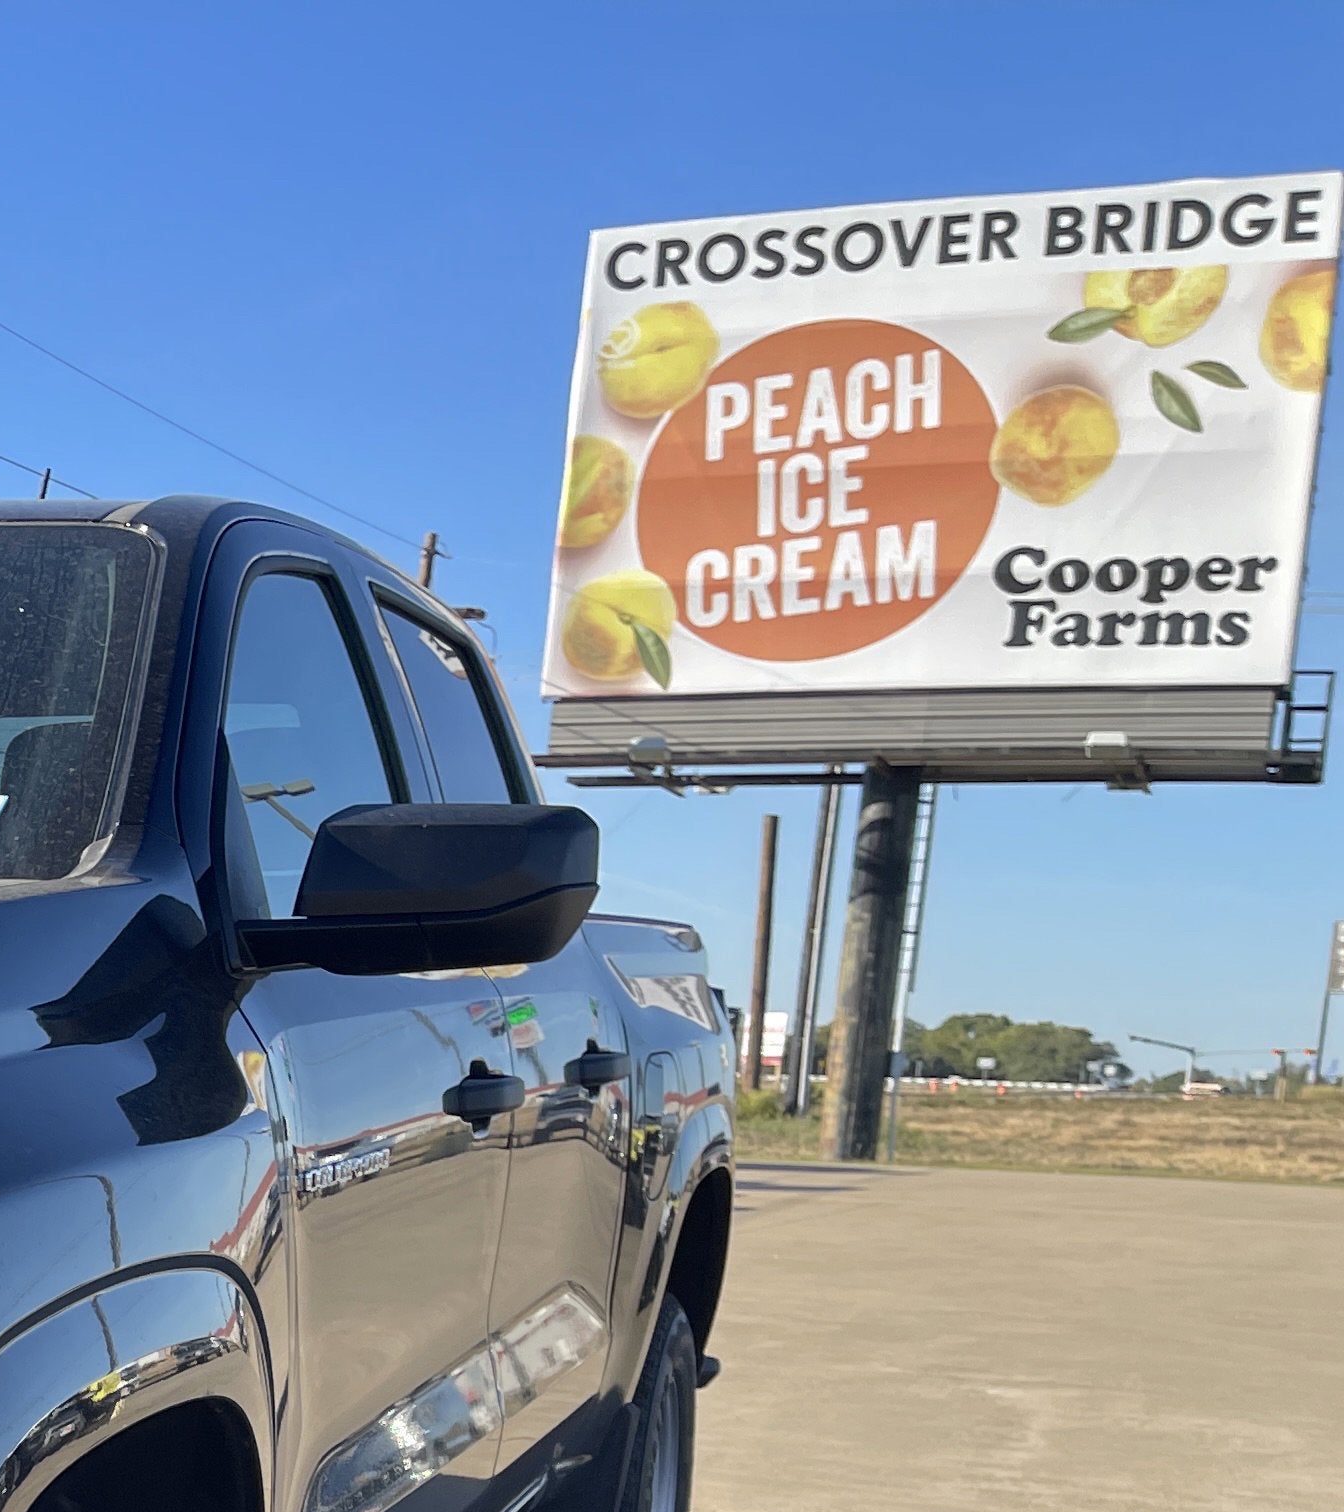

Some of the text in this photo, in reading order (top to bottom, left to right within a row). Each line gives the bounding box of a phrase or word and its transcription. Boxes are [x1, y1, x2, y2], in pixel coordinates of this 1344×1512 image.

[605, 188, 1325, 292] CROSSOVER BRIDGE
[704, 348, 943, 462] PEACH
[756, 445, 869, 538] ICE
[683, 520, 937, 629] CREAM
[991, 546, 1280, 604] Cooper
[1002, 600, 1251, 650] Farms
